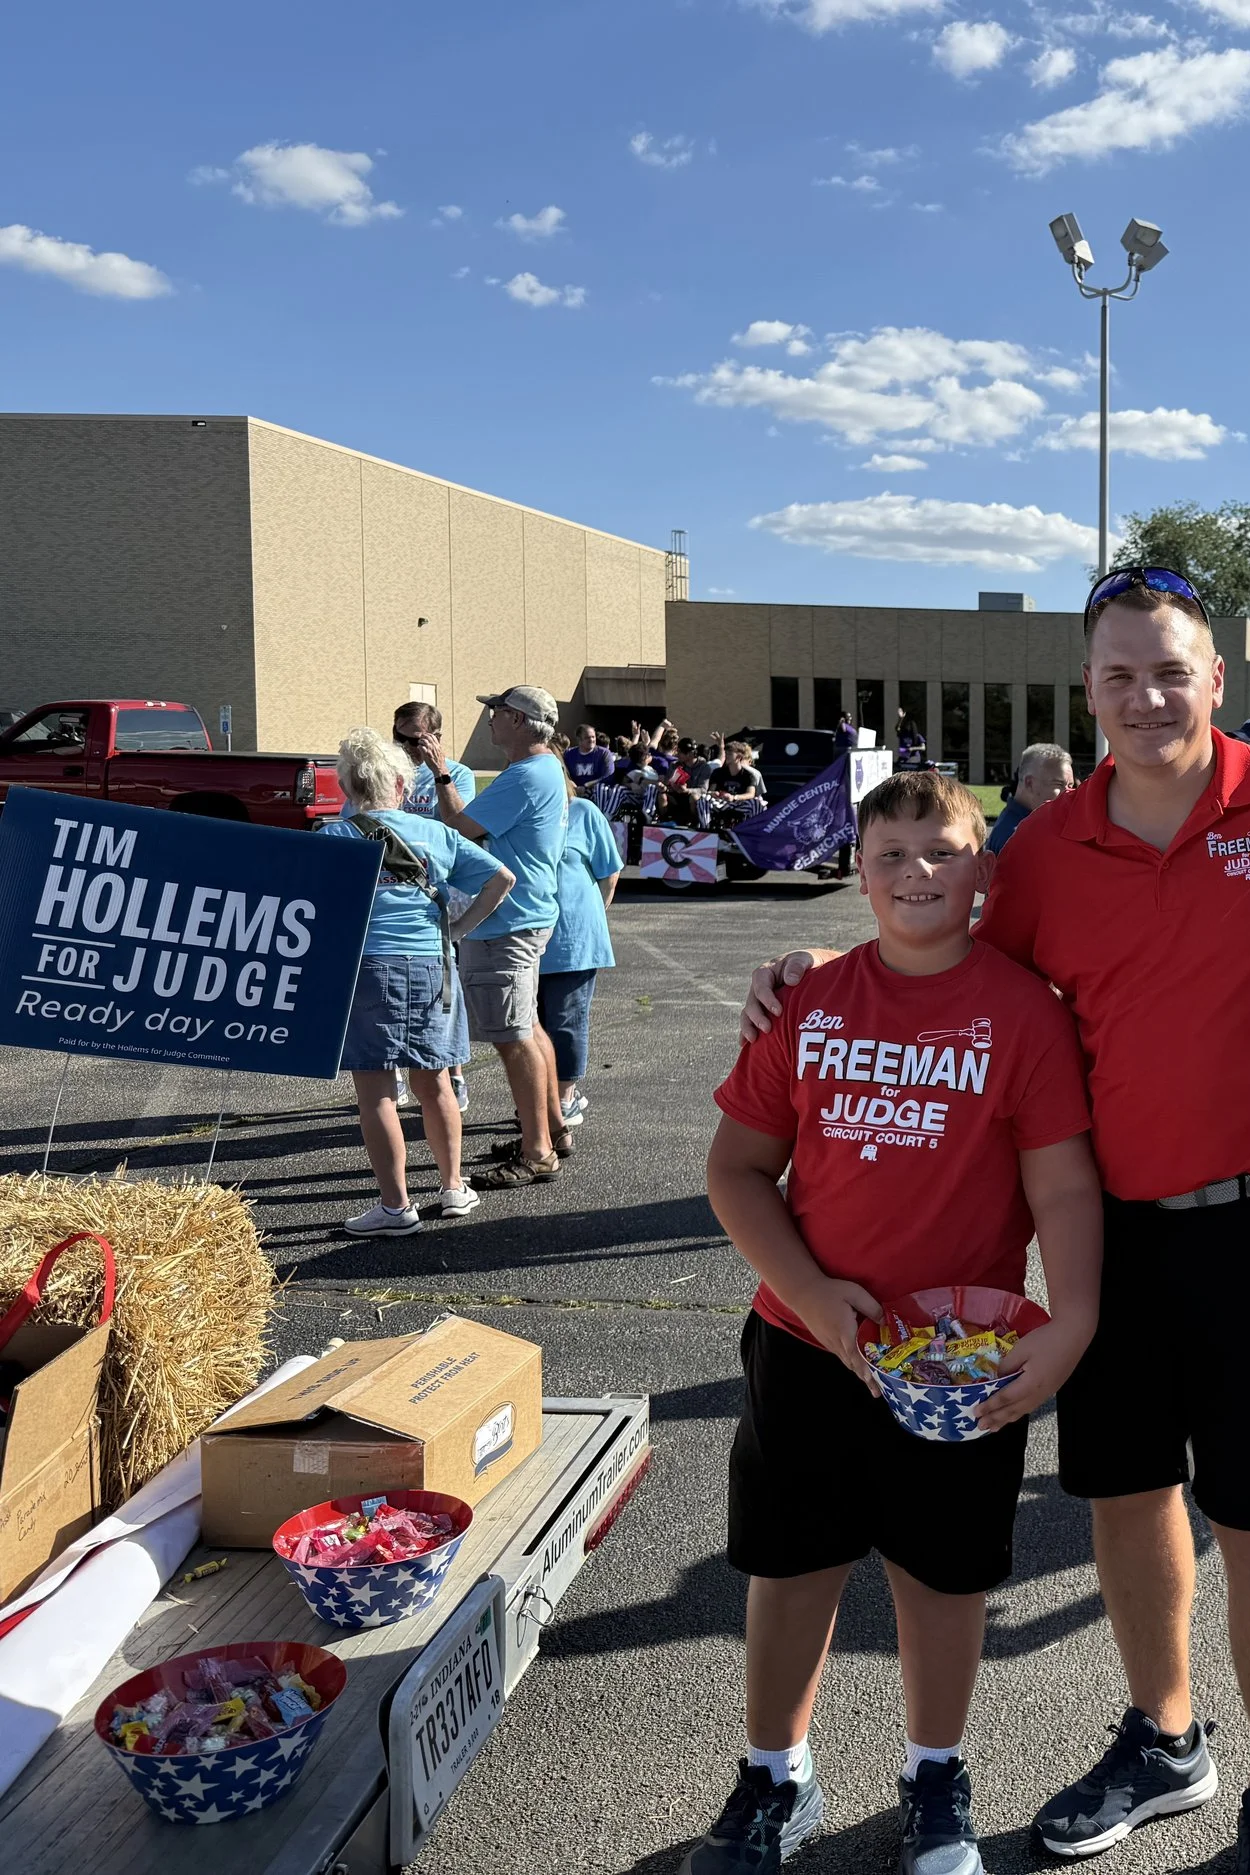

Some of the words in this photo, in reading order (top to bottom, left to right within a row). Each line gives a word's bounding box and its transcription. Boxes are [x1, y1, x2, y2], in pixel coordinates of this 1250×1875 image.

[576, 763, 594, 776] M
[763, 801, 799, 834] MUNCIE
[52, 818, 138, 868] TIM
[1206, 832, 1222, 840] Ben
[35, 864, 316, 958] HOLLEMS
[37, 944, 100, 979] FOR
[112, 947, 303, 1011] JUDGE
[15, 990, 135, 1033] Ready
[144, 1007, 215, 1042] day
[224, 1021, 289, 1045] one
[799, 1009, 845, 1030] Ben
[58, 1037, 76, 1046] Paid
[77, 1039, 89, 1047] for
[91, 1040, 101, 1049] by
[102, 1042, 116, 1050] the
[117, 1044, 149, 1054] Hollems
[151, 1047, 163, 1055] for
[163, 1049, 186, 1058] Judge
[187, 1051, 231, 1062] Committee
[798, 1031, 991, 1095] FREEMAN
[880, 1085, 901, 1098] for
[820, 1093, 949, 1131] JUDGE
[823, 1127, 873, 1142] CIRCUIT
[875, 1132, 925, 1147] COURT
[929, 1138, 938, 1149] 5
[408, 1379, 444, 1404] PROTECT
[440, 1365, 464, 1380] FROM
[459, 1352, 481, 1366] HEAT
[411, 1356, 457, 1389] PERISHABLE
[542, 1417, 648, 1583] AluminumTrailer.com
[430, 1635, 472, 1700] INDIANA
[415, 1639, 493, 1782] TR337AFD
[491, 1689, 500, 1709] 18
[451, 1745, 468, 1774] TRAILER
